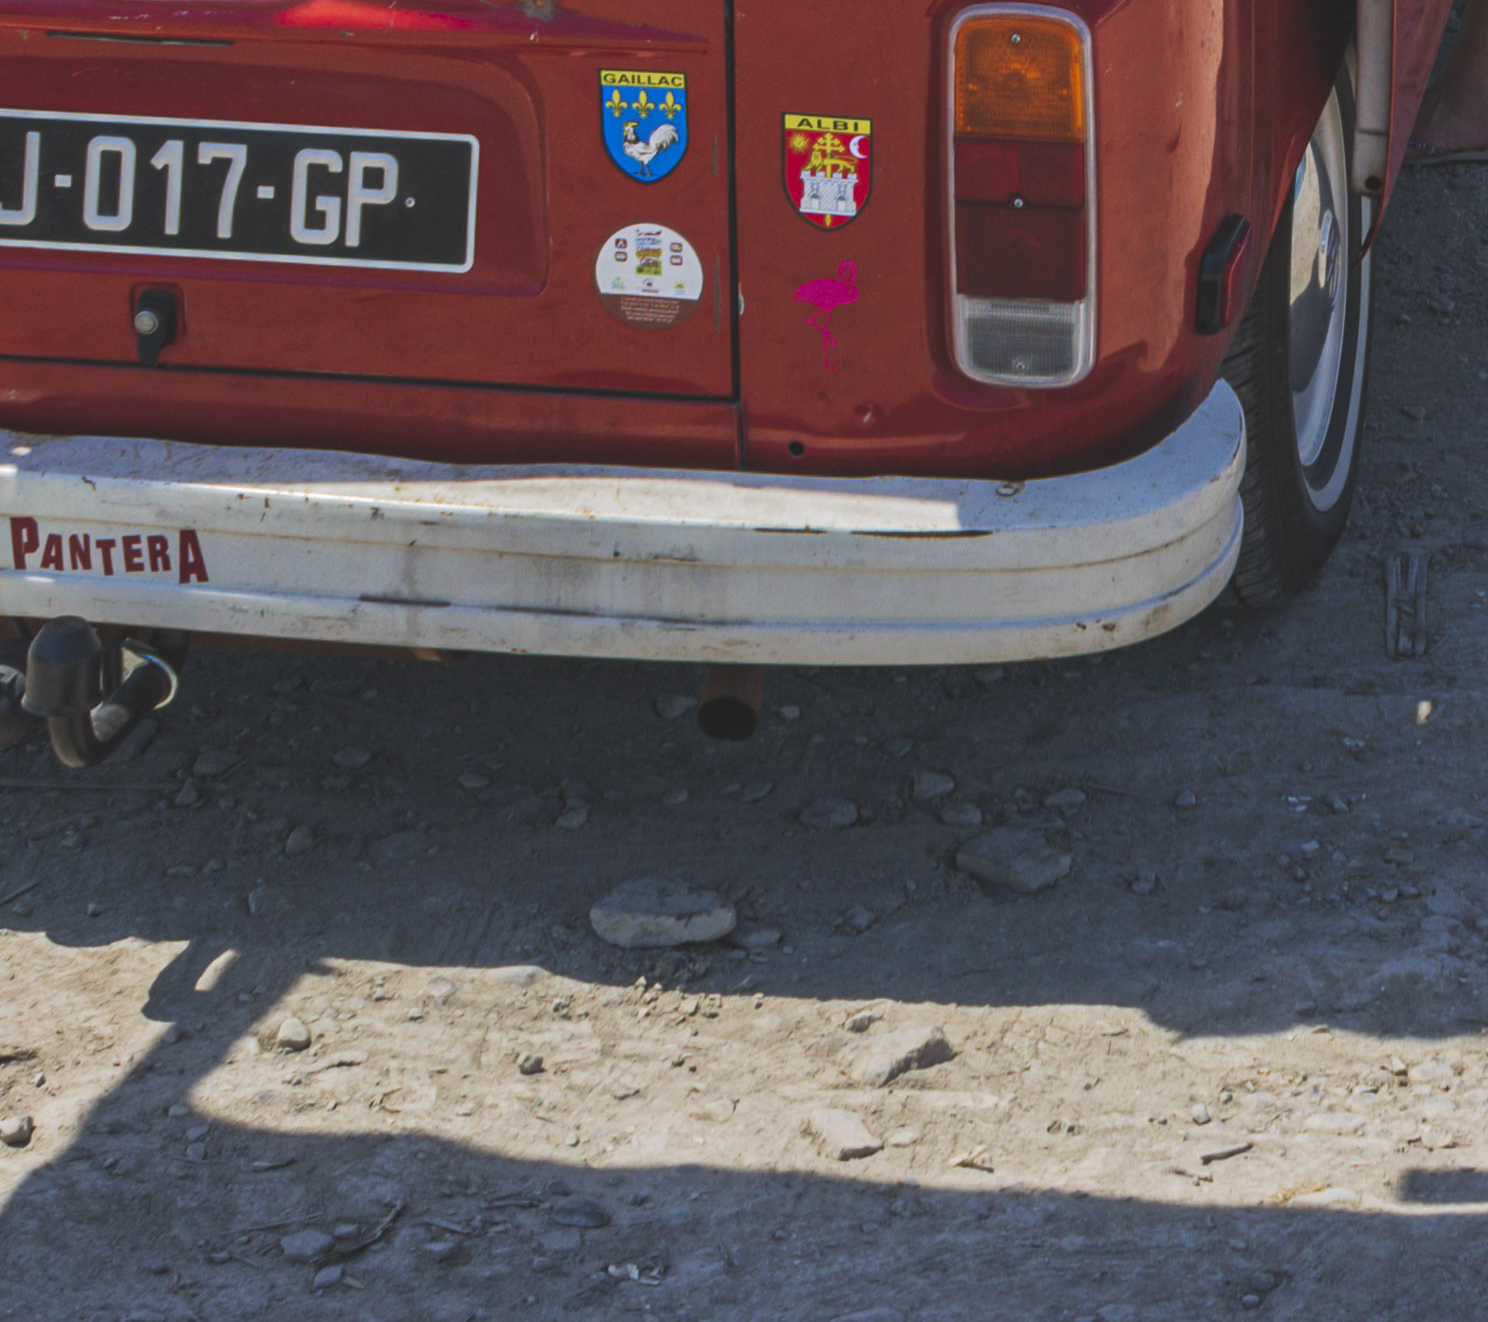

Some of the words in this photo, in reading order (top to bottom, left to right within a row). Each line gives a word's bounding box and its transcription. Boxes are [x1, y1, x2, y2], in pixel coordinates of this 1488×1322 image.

[602, 72, 683, 87] GAILLAC
[797, 117, 859, 132] ALBI
[9, 516, 210, 585] PANTERA
